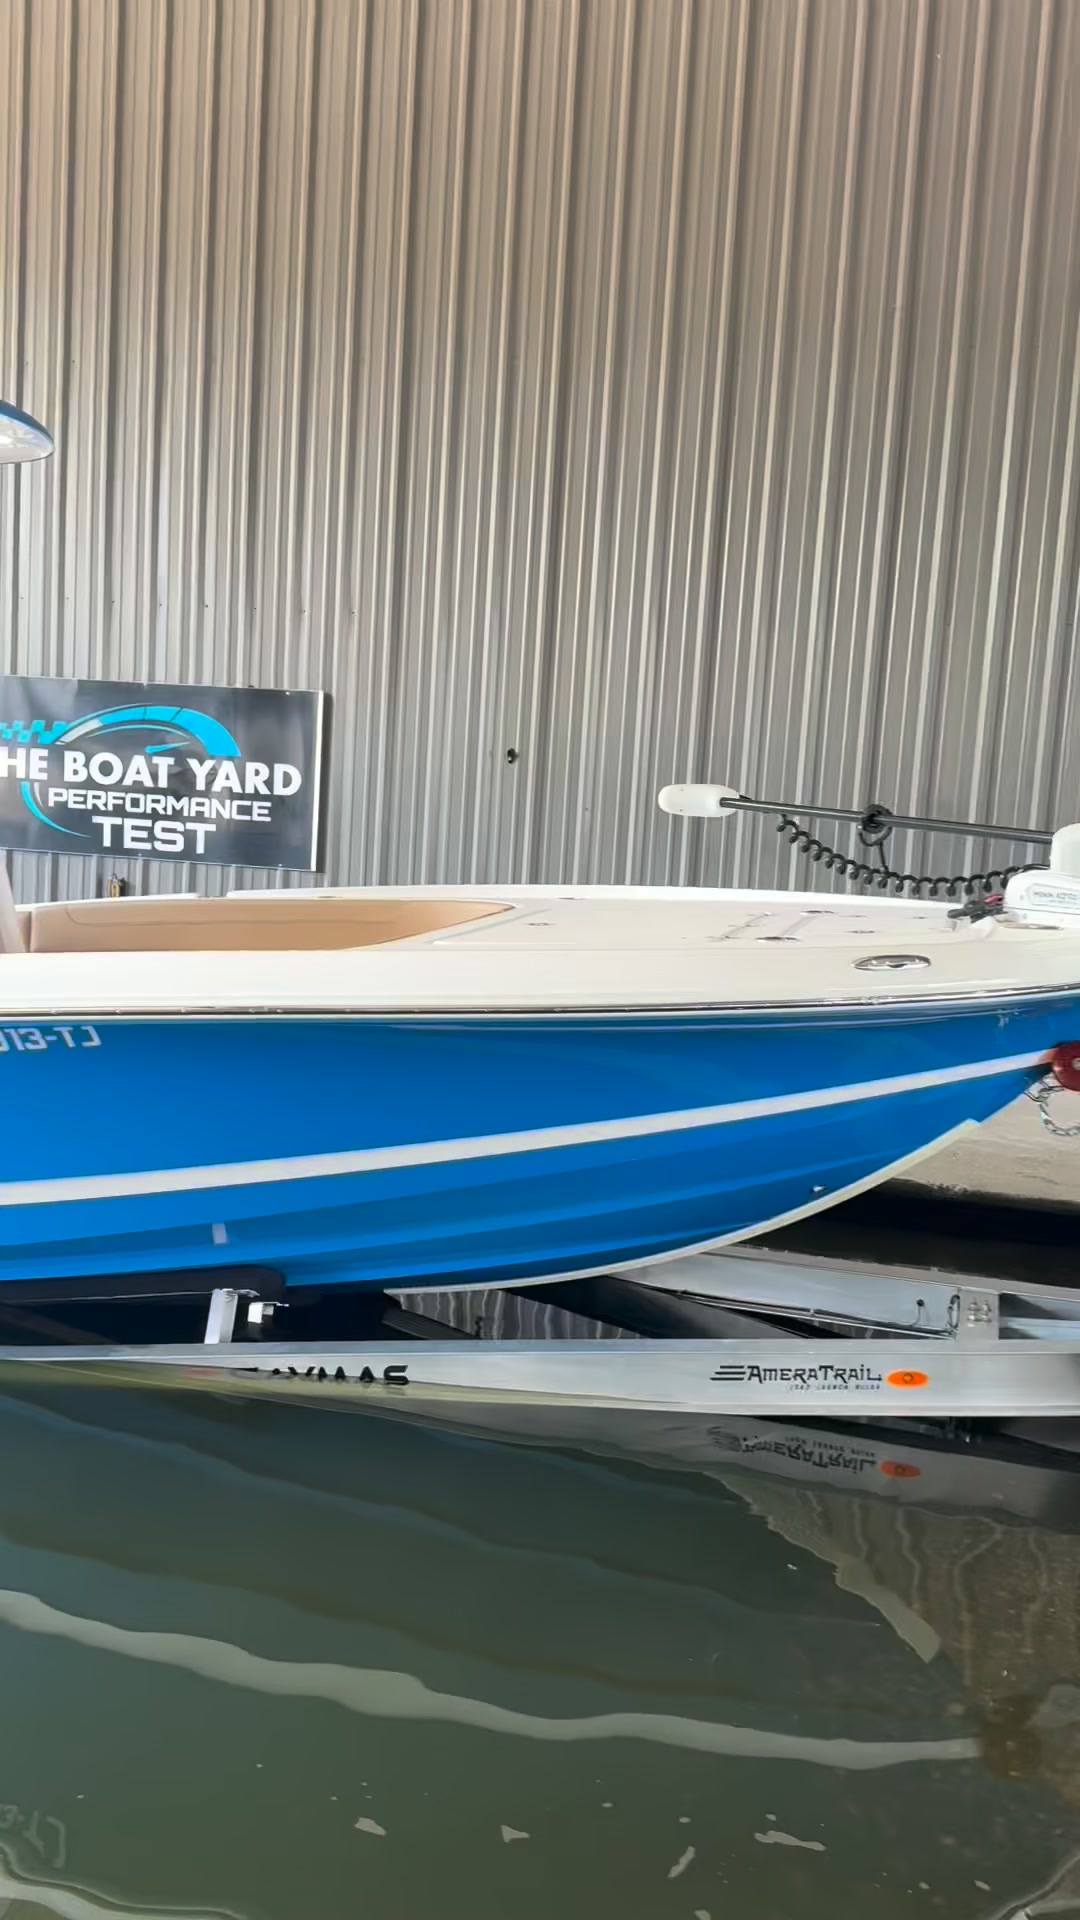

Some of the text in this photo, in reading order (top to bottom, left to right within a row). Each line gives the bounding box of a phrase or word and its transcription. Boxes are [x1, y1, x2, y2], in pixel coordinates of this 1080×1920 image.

[0, 746, 302, 796] HE BOAT YARD
[48, 787, 272, 822] PERFORMANCE
[92, 816, 217, 854] TEST
